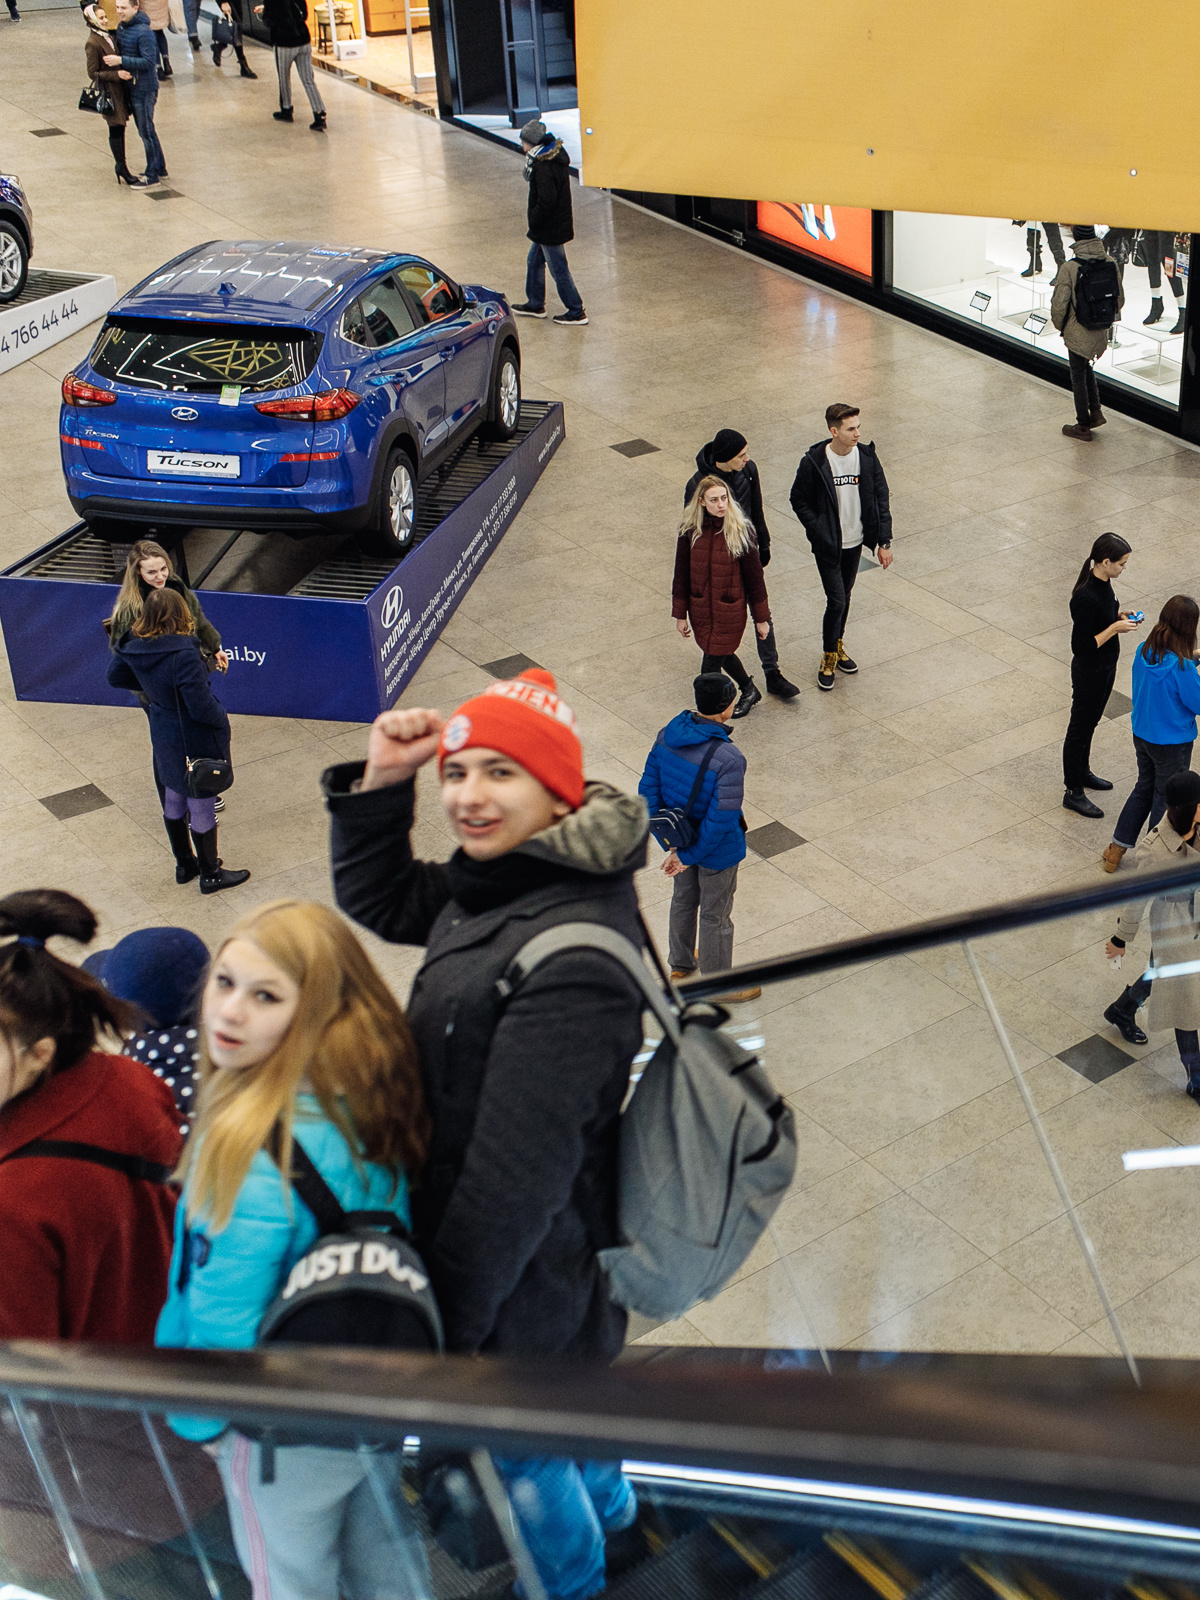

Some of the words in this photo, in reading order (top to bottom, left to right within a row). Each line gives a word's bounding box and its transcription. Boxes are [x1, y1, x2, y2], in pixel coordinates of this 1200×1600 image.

[0, 336, 10, 353] 4
[11, 320, 39, 349] 766
[42, 309, 59, 331] 44
[61, 298, 79, 320] 44
[85, 429, 119, 440] TUCSON
[157, 455, 229, 469] TUCSON
[219, 645, 266, 666] ai.by
[381, 609, 411, 662] HYUNDAI
[386, 658, 409, 697] Автоцентр
[422, 618, 437, 641] Центр
[385, 639, 408, 681] Автоцентр
[282, 1242, 361, 1300] JUST
